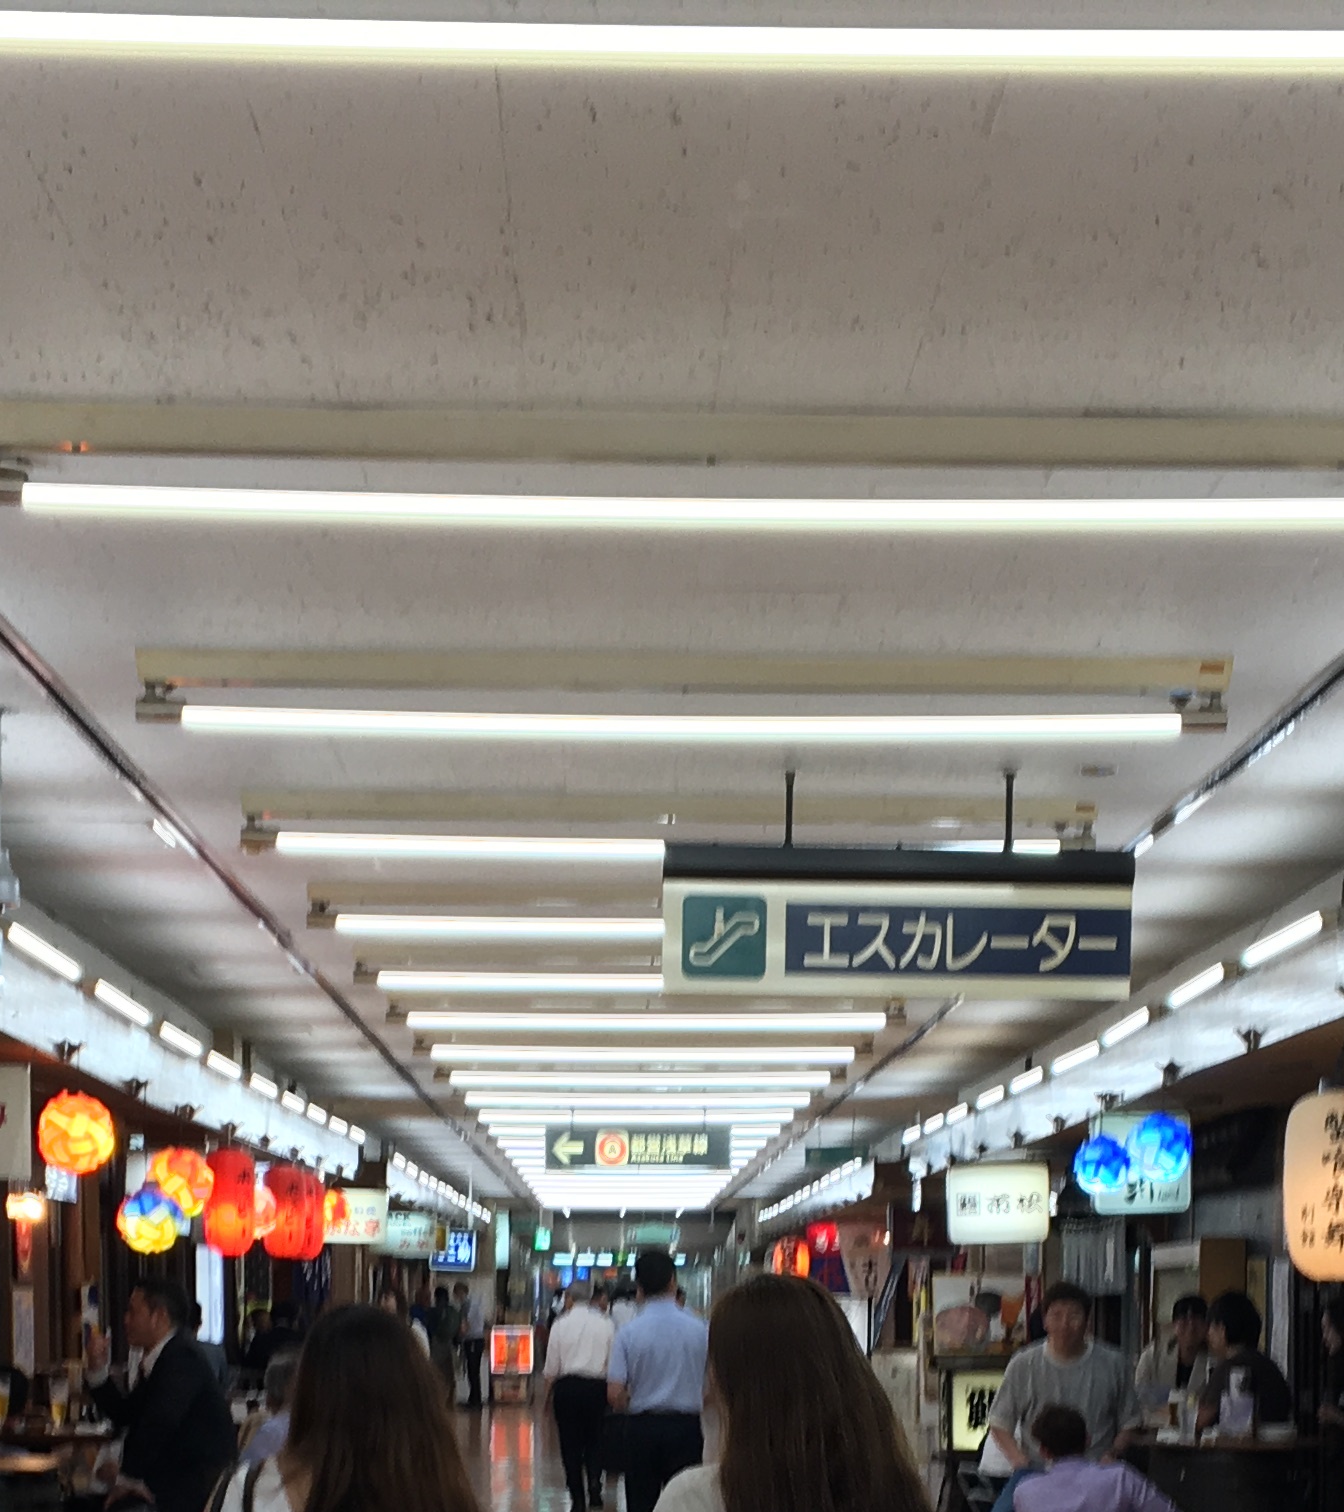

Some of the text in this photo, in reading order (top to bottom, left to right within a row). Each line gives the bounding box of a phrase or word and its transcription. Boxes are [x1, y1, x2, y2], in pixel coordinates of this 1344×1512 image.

[802, 909, 1119, 972] エスカレーター
